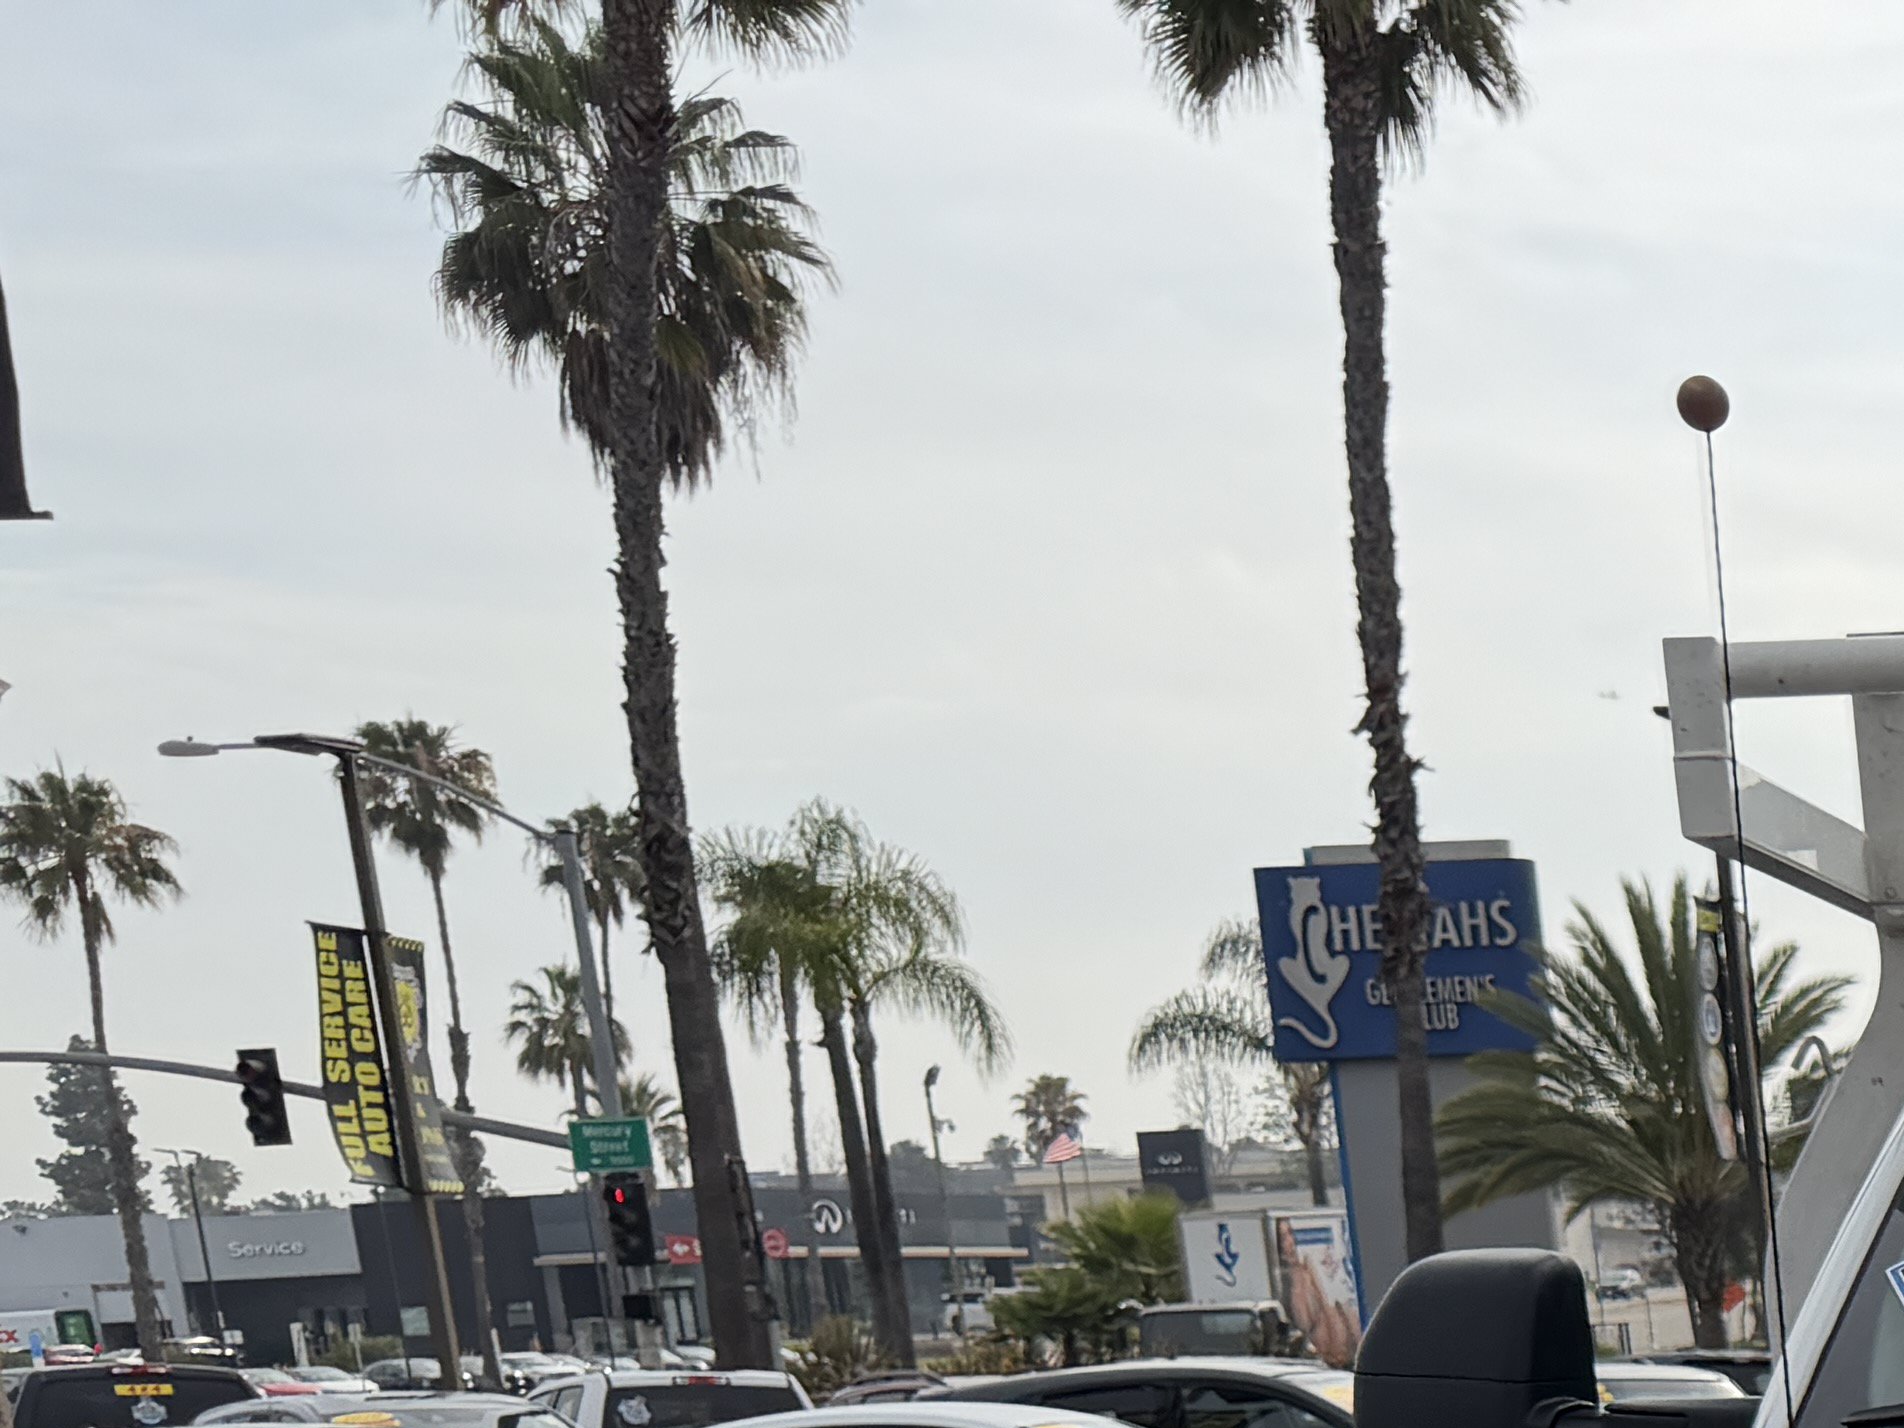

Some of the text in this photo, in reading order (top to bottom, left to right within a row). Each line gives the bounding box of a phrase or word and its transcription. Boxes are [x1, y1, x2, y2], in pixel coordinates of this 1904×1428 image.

[317, 930, 376, 1177] FULL SERVICE
[342, 959, 394, 1157] AUTO CARE
[1420, 1002, 1459, 1031] LUB
[228, 1241, 303, 1258] Service
